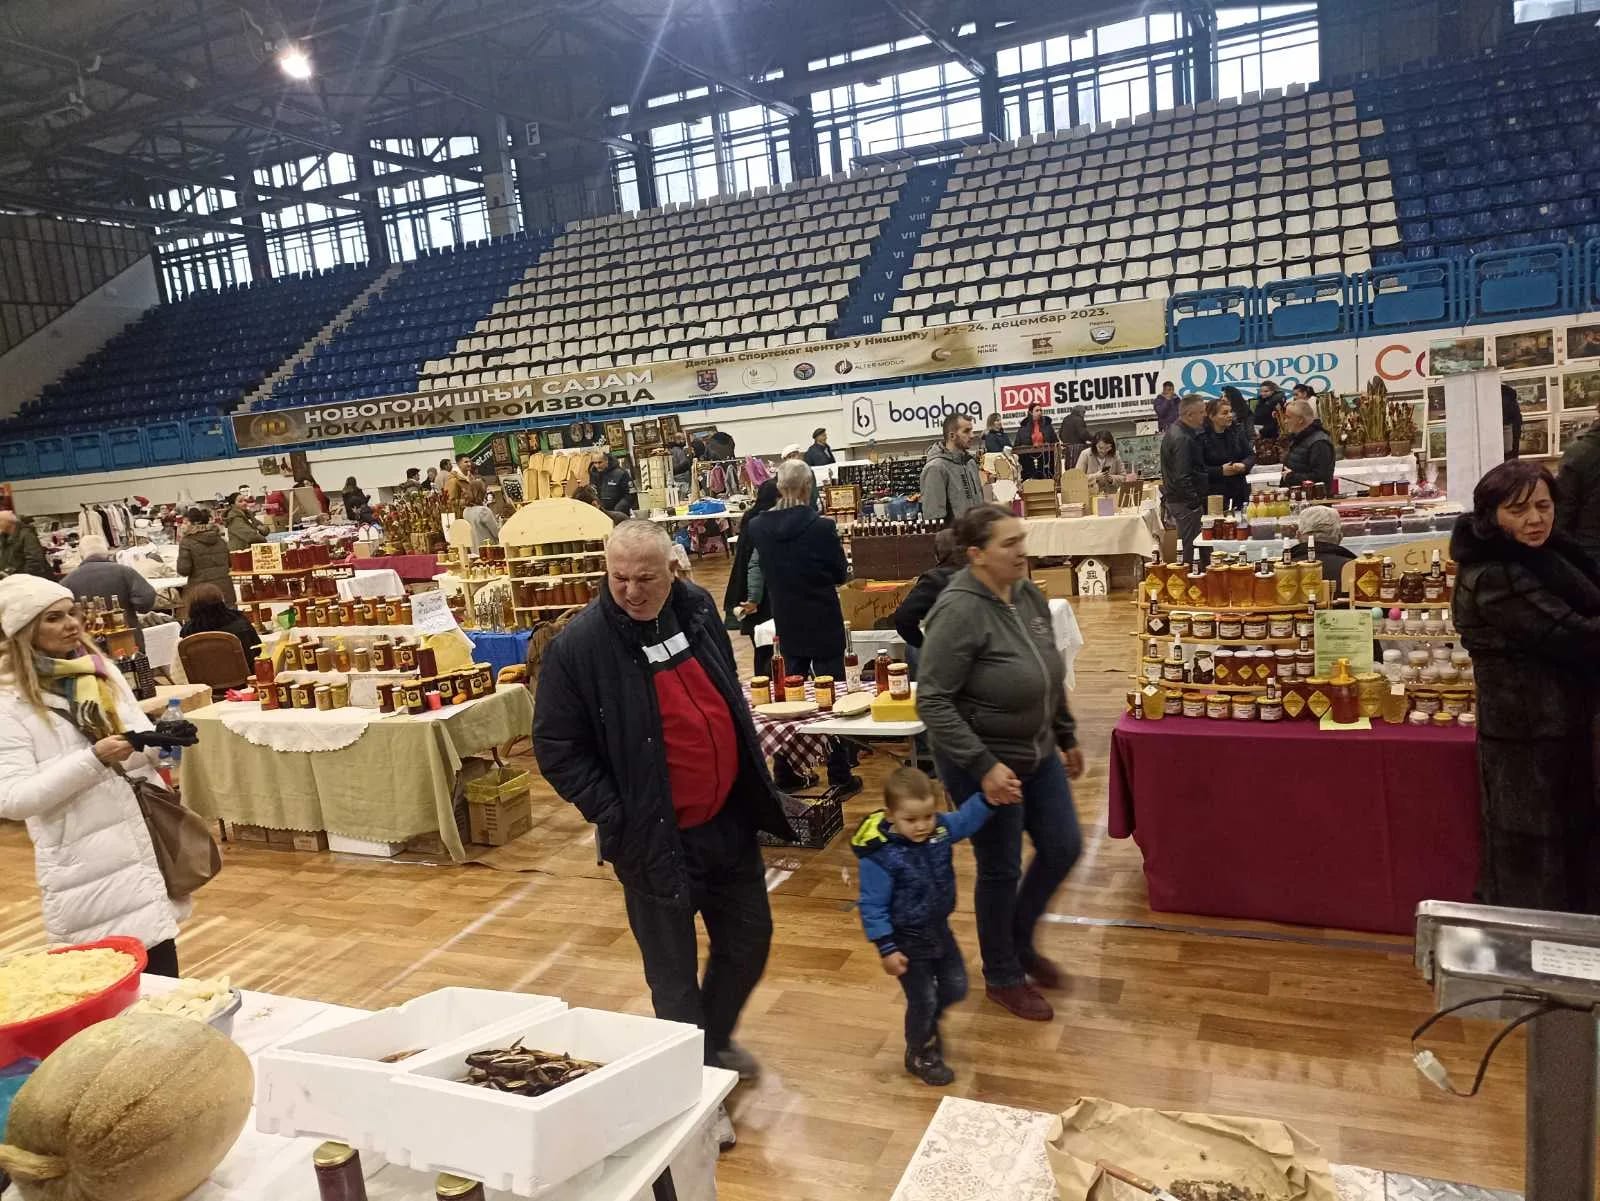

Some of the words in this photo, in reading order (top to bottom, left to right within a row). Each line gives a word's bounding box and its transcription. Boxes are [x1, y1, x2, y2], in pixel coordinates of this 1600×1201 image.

[893, 251, 905, 259] VI
[885, 271, 895, 280] V
[873, 292, 885, 302] IV
[863, 314, 873, 325] III
[991, 314, 1066, 331] децембар
[1070, 307, 1109, 320] 2023.
[685, 356, 736, 369] Дворана
[738, 344, 802, 360] Спортског
[804, 341, 850, 353] центра
[853, 340, 861, 348] у
[865, 330, 929, 345] Никшићу
[305, 385, 534, 424] НОВОГОДИШЊИ
[542, 369, 653, 396] САЈАМ
[1003, 386, 1047, 408] DON
[1054, 371, 1159, 404] SECURITY
[306, 410, 455, 439] ЛОКАЛНИХ
[464, 388, 655, 421] ПРОИЗВОДА
